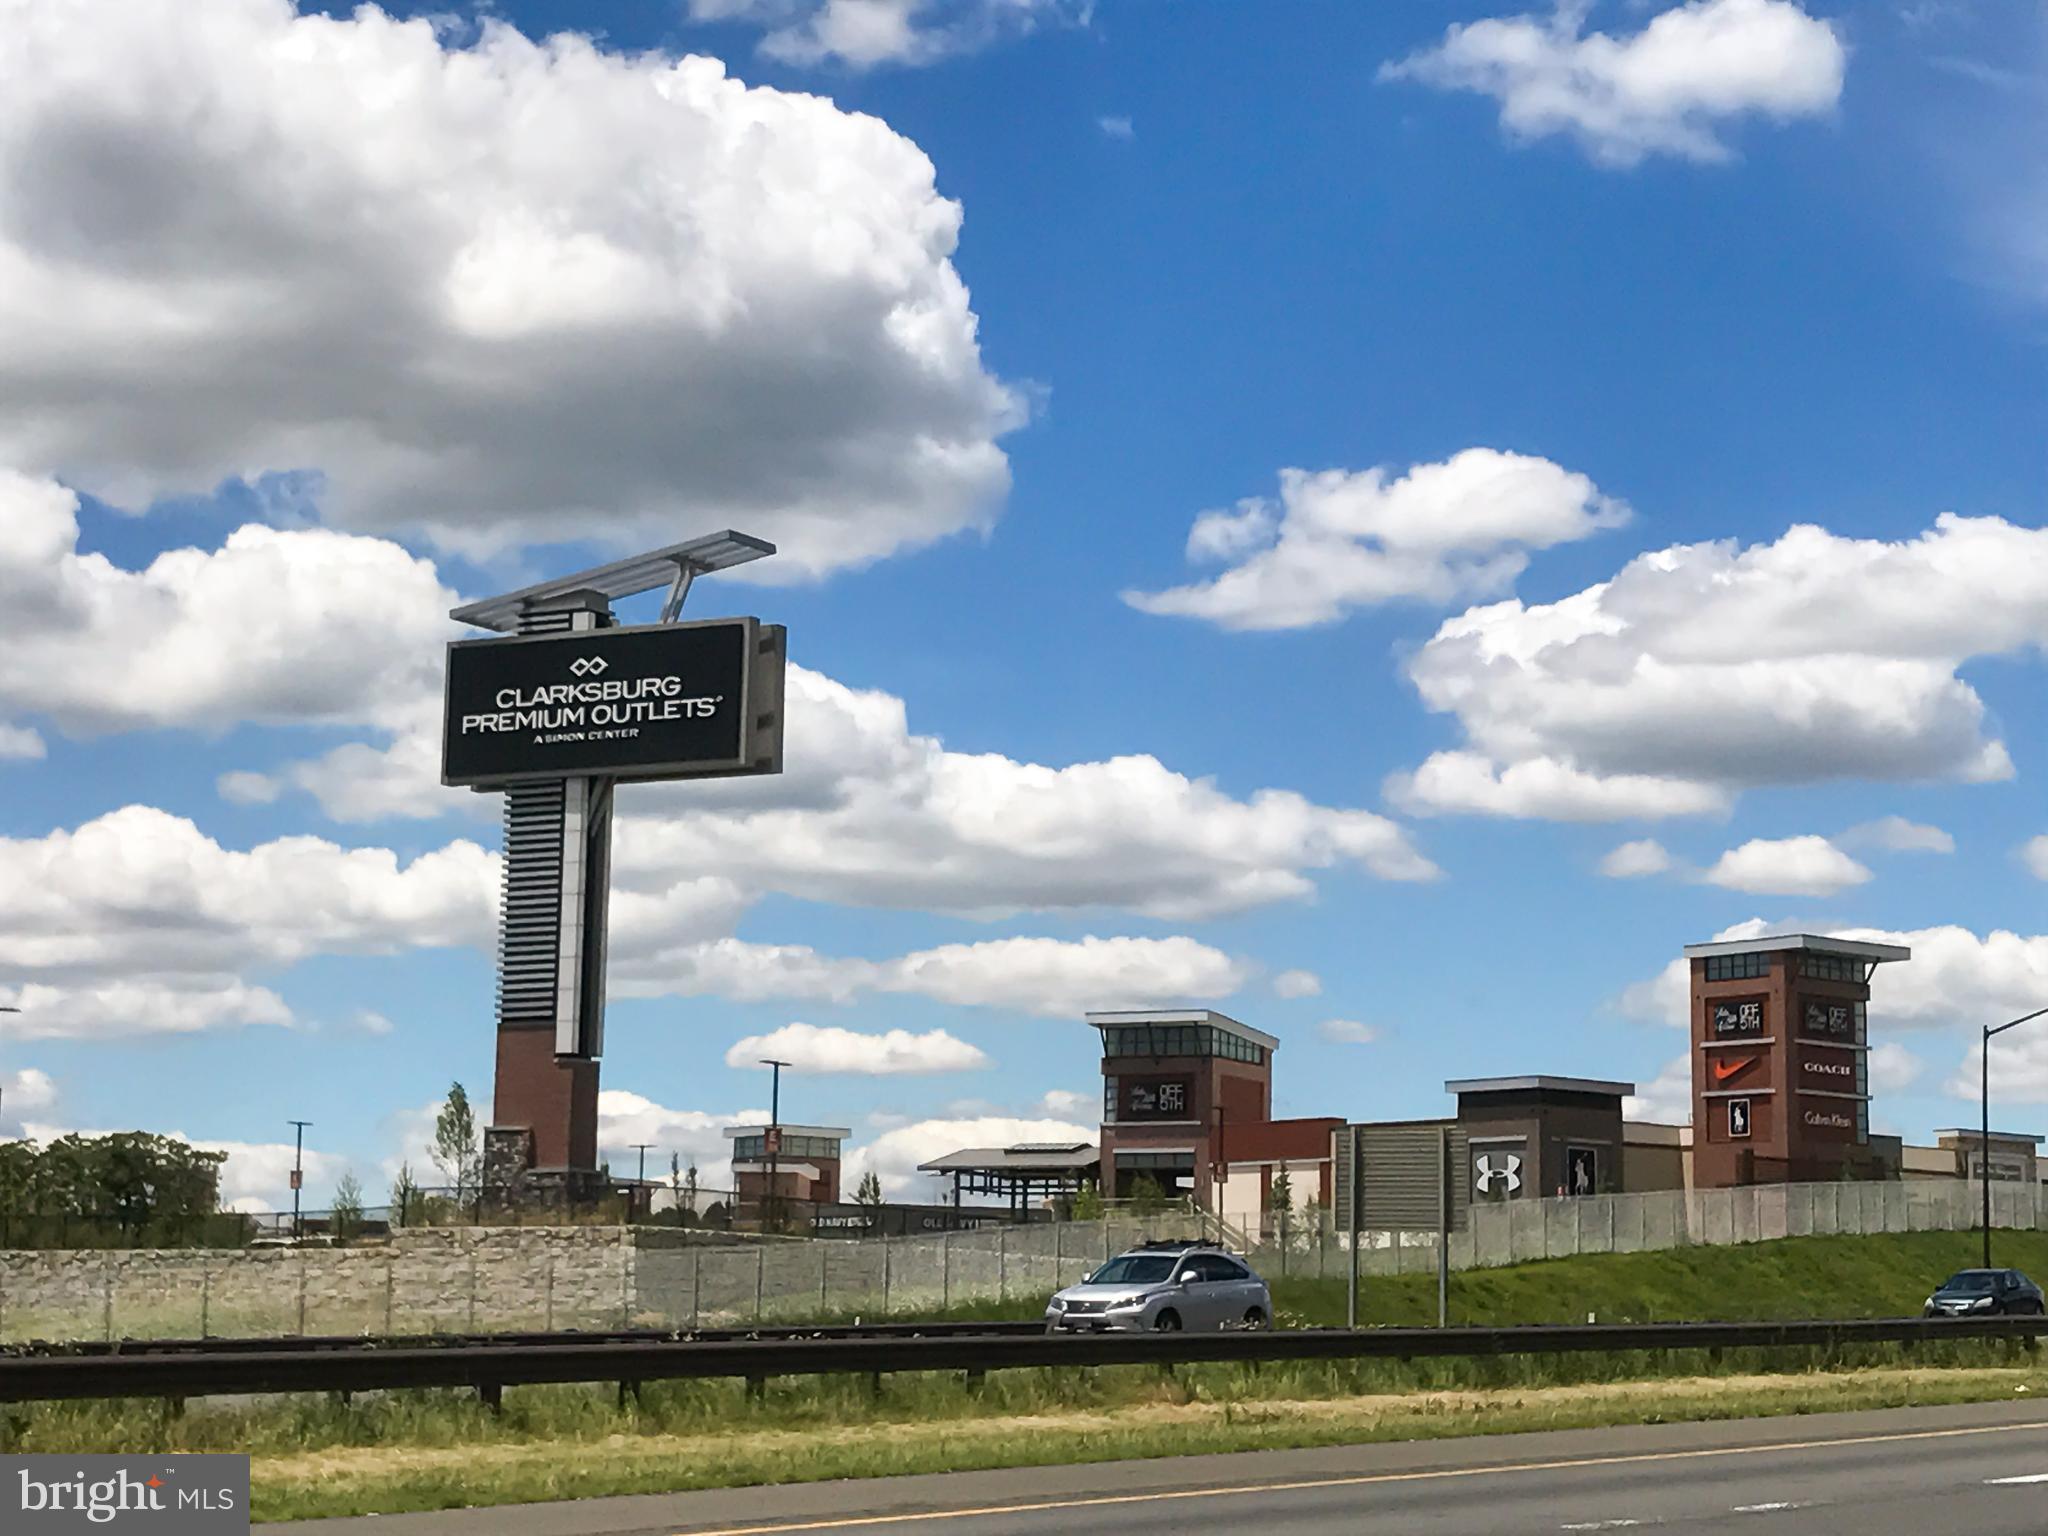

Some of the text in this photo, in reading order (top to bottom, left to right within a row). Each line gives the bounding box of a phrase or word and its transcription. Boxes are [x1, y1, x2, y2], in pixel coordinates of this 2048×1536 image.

[495, 675, 682, 710] CLARKSBURG
[462, 705, 585, 735] PREMIUM
[533, 728, 640, 744] A SIMON CENTER
[1739, 1003, 1759, 1019] OFF
[1803, 1062, 1851, 1076] COACH
